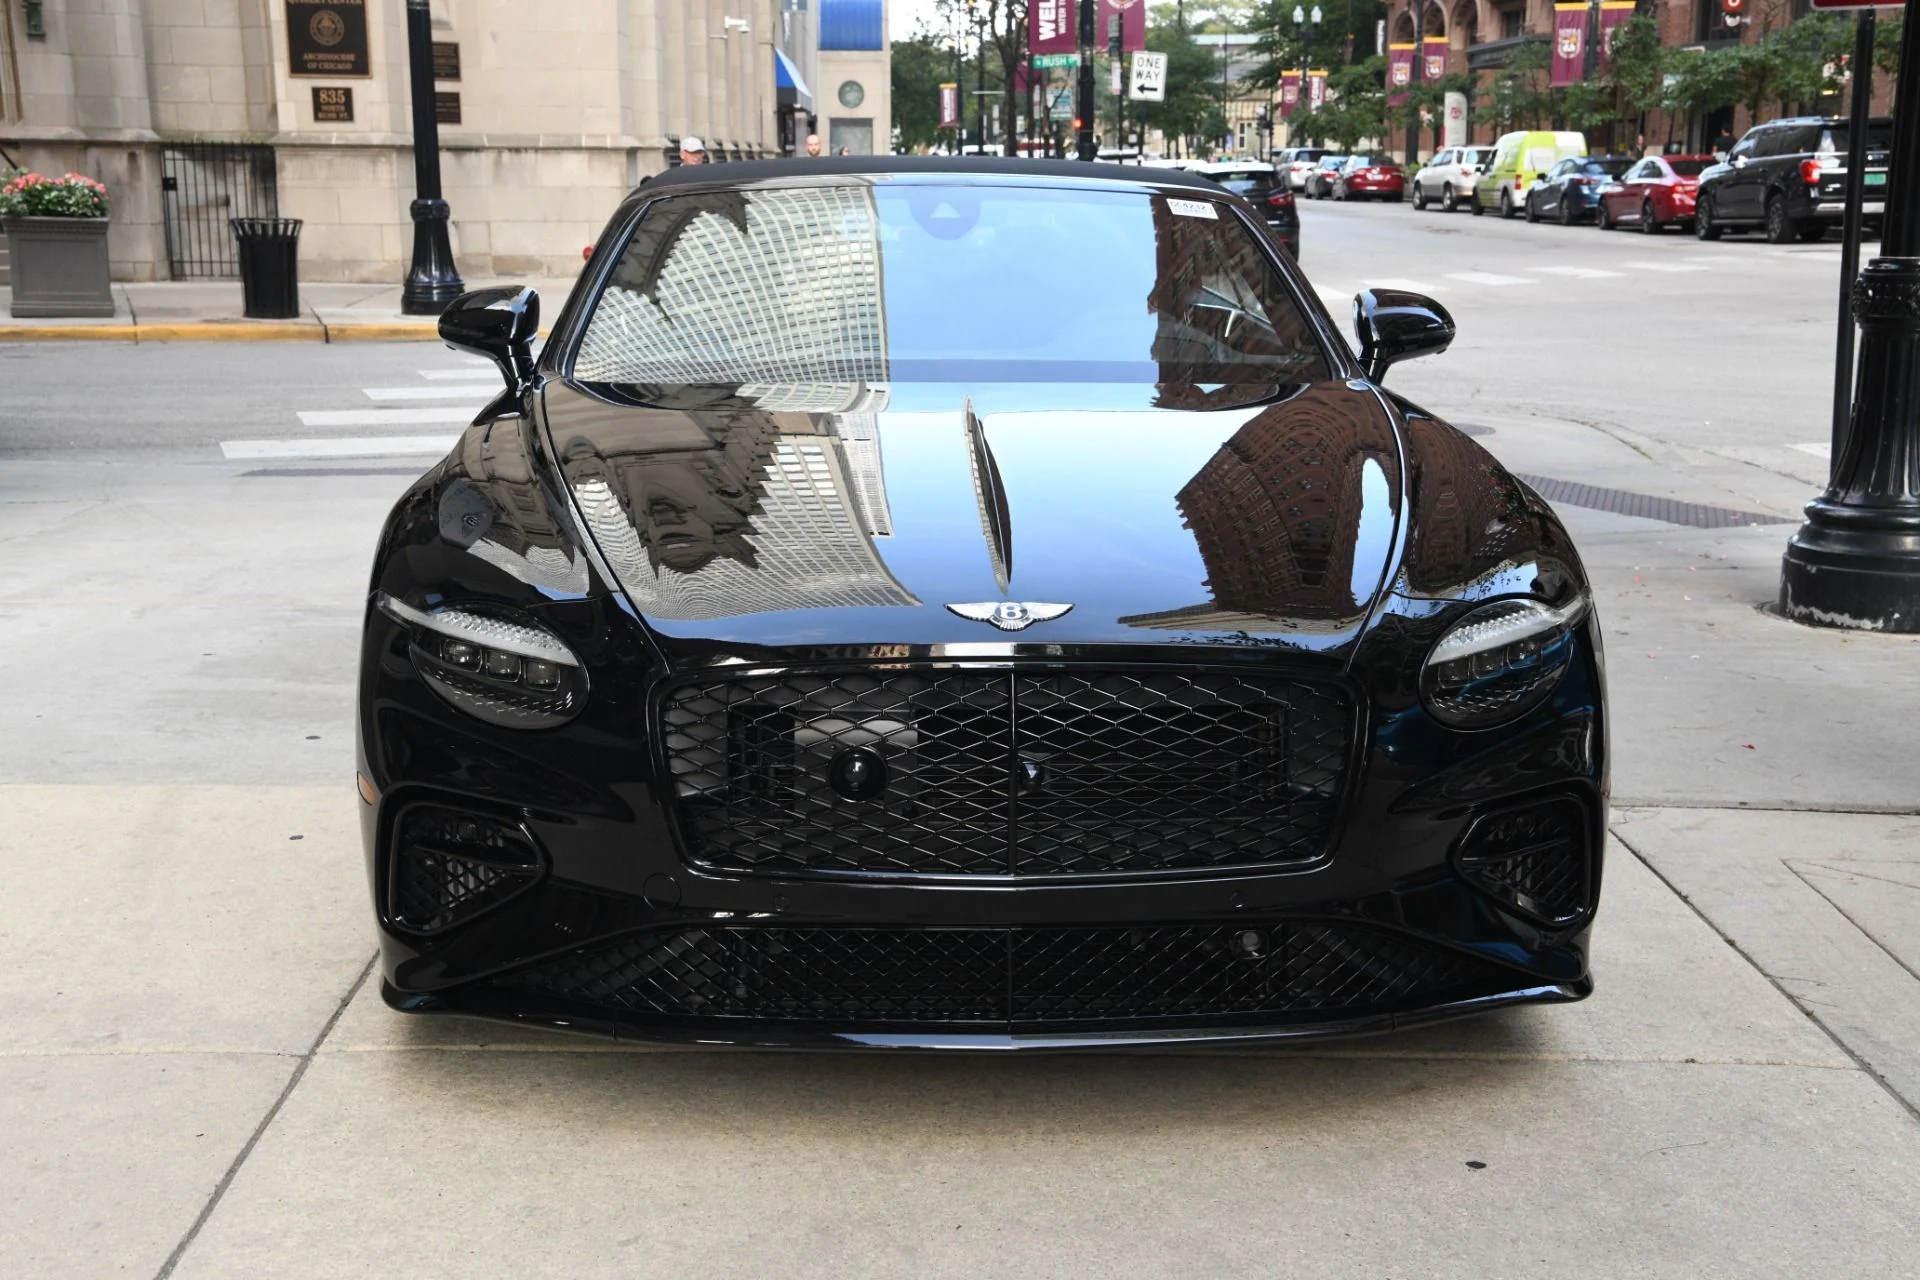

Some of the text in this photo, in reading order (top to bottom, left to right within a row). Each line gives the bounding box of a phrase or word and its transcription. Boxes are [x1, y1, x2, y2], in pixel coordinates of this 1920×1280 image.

[1043, 56, 1066, 67] RUSH
[1137, 57, 1161, 69] ONE
[1136, 70, 1160, 80] WAY
[319, 89, 345, 104] 835
[1000, 604, 1022, 619] B
